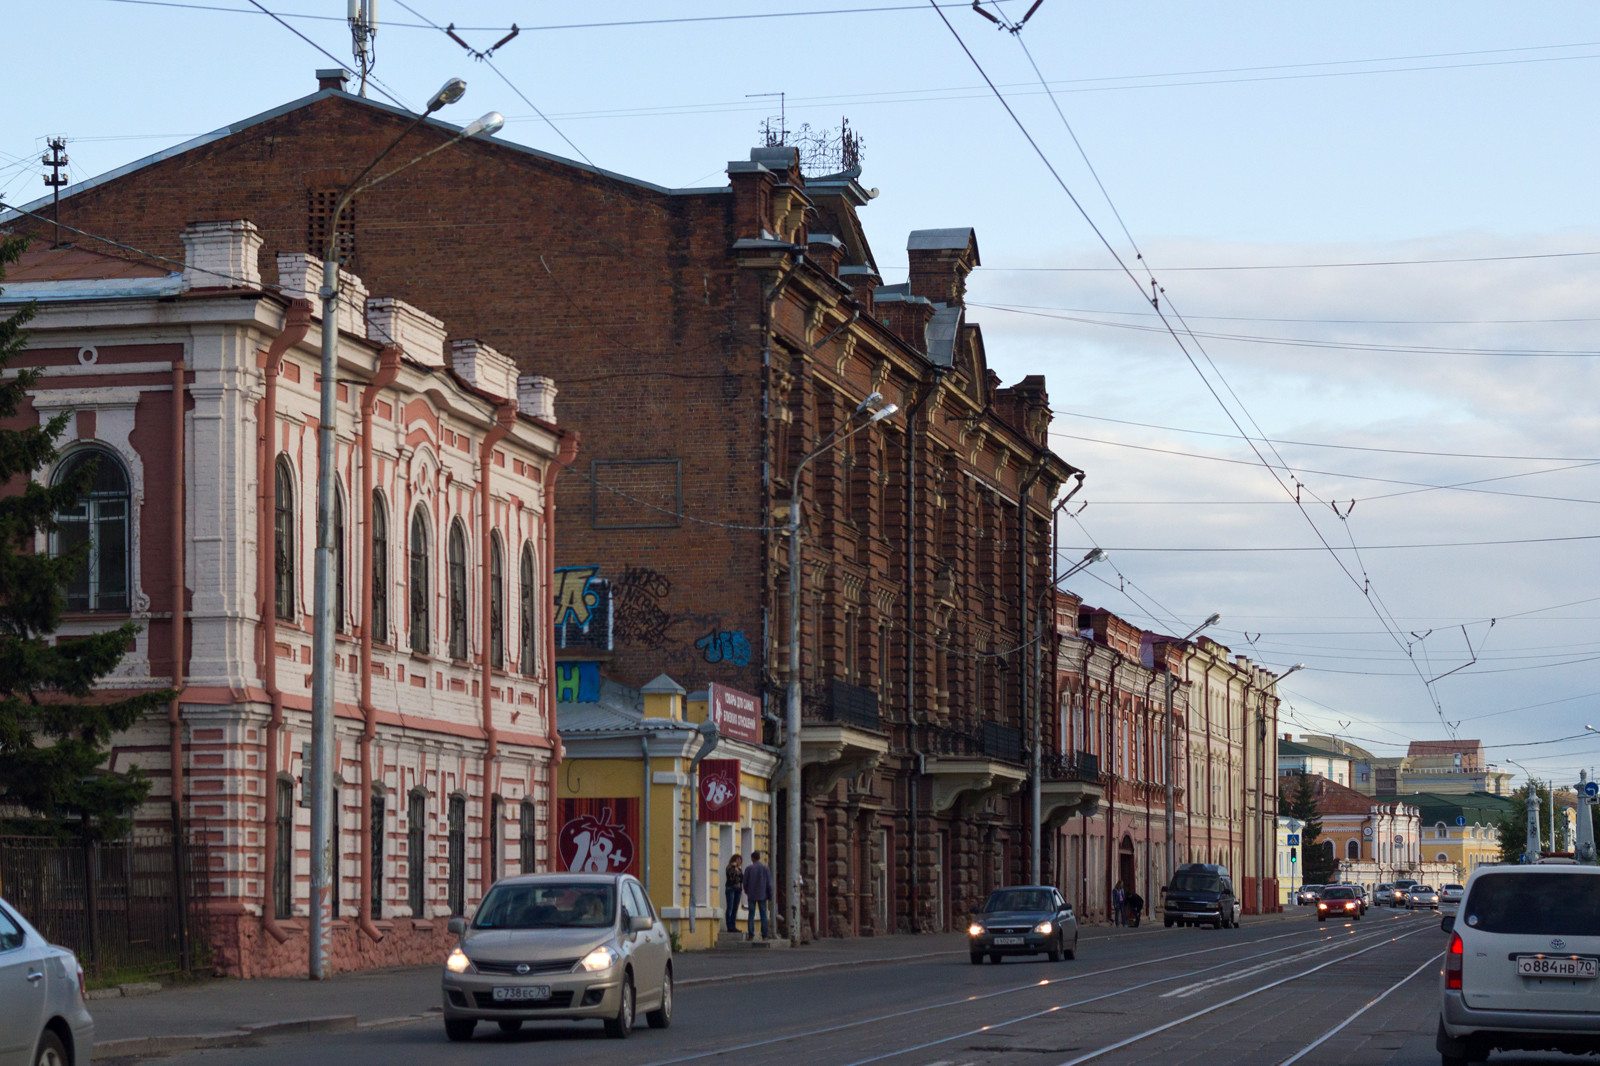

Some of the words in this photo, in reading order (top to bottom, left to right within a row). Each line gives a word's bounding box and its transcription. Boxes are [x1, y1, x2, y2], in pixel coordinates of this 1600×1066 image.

[706, 781, 733, 804] 18+
[570, 831, 627, 872] 18+
[1579, 961, 1592, 971] 70
